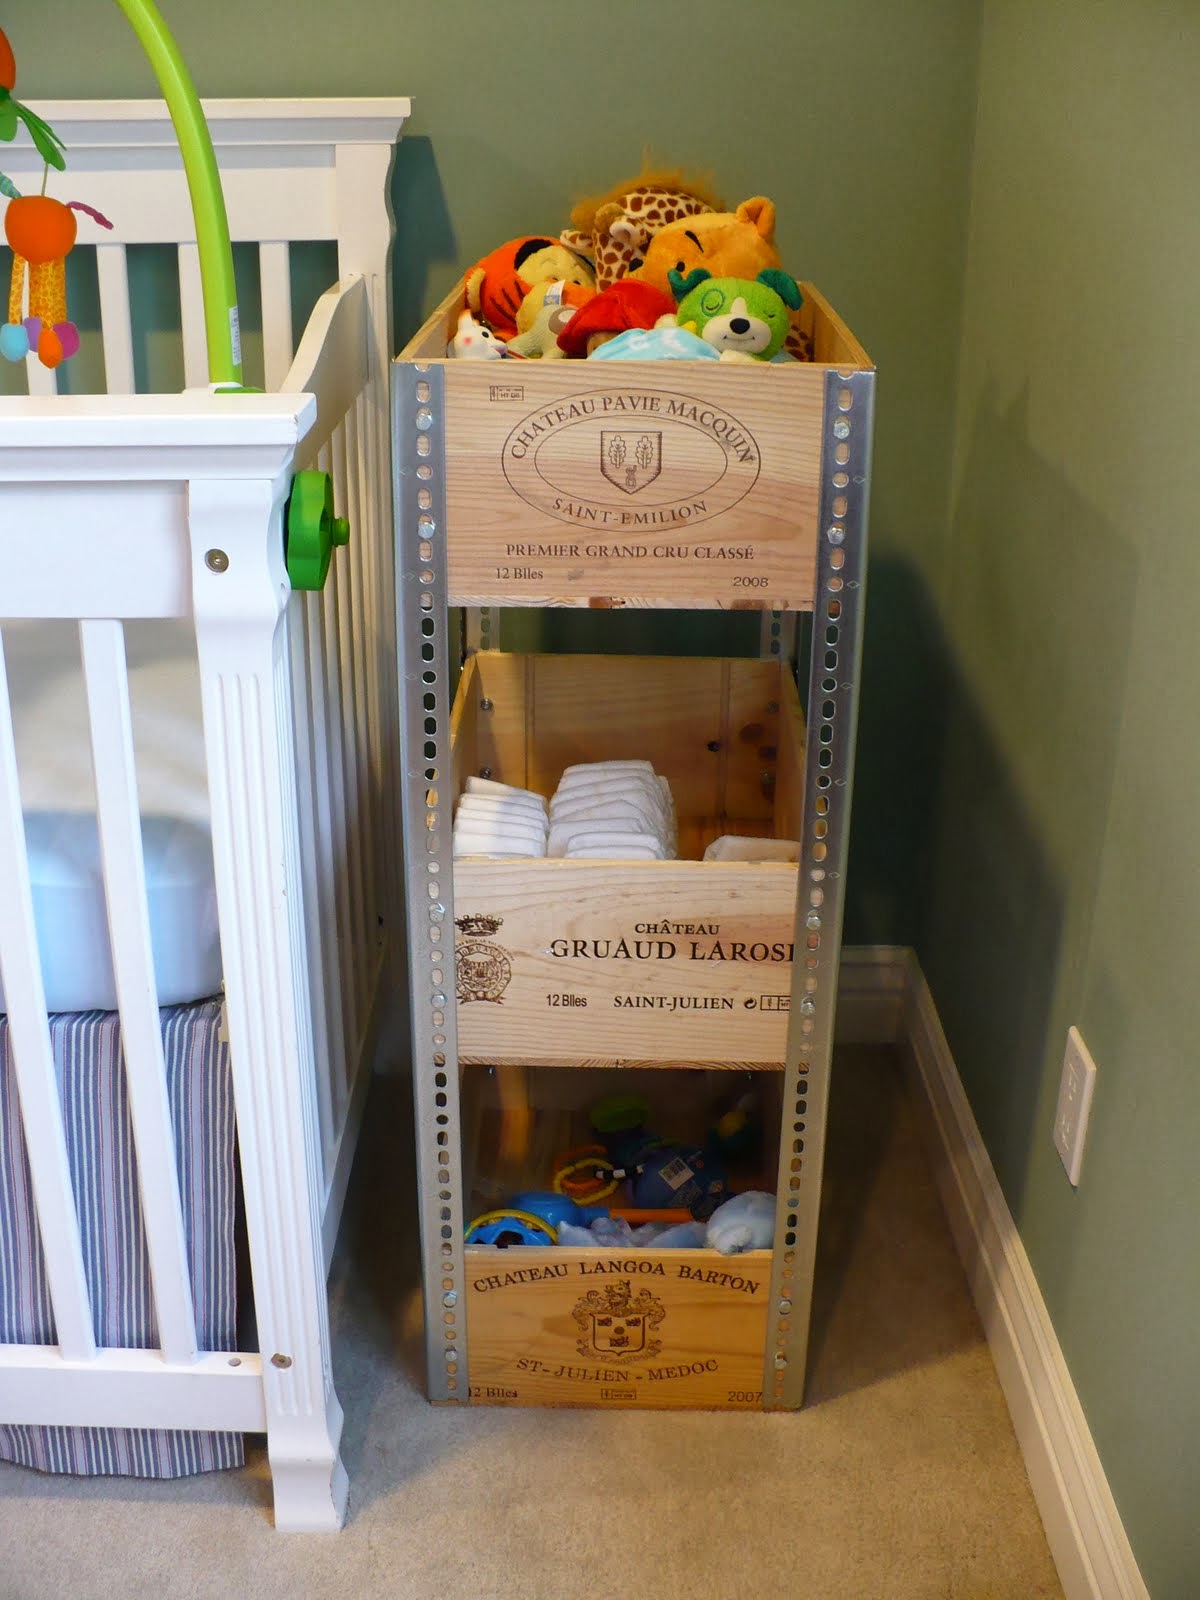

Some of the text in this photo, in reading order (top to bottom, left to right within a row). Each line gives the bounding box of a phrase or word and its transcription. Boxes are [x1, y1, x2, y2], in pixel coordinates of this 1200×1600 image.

[511, 395, 756, 463] CHATEAU PAVIE MACQUIN
[552, 498, 707, 526] SAINT-EMILION
[505, 543, 755, 560] PREMIER GRAND CRU CLASSÉ
[496, 567, 510, 580] 12
[732, 576, 769, 588] 2008
[634, 919, 721, 936] CHÂTEAU
[550, 938, 676, 960] GRUAUD
[546, 994, 560, 1007] 12
[613, 996, 734, 1011] SAINT-JULIEN
[473, 1261, 761, 1295] CHATEAU LANGOA BARTON
[648, 1359, 719, 1381] MEDOC
[728, 1391, 763, 1403] 2007
